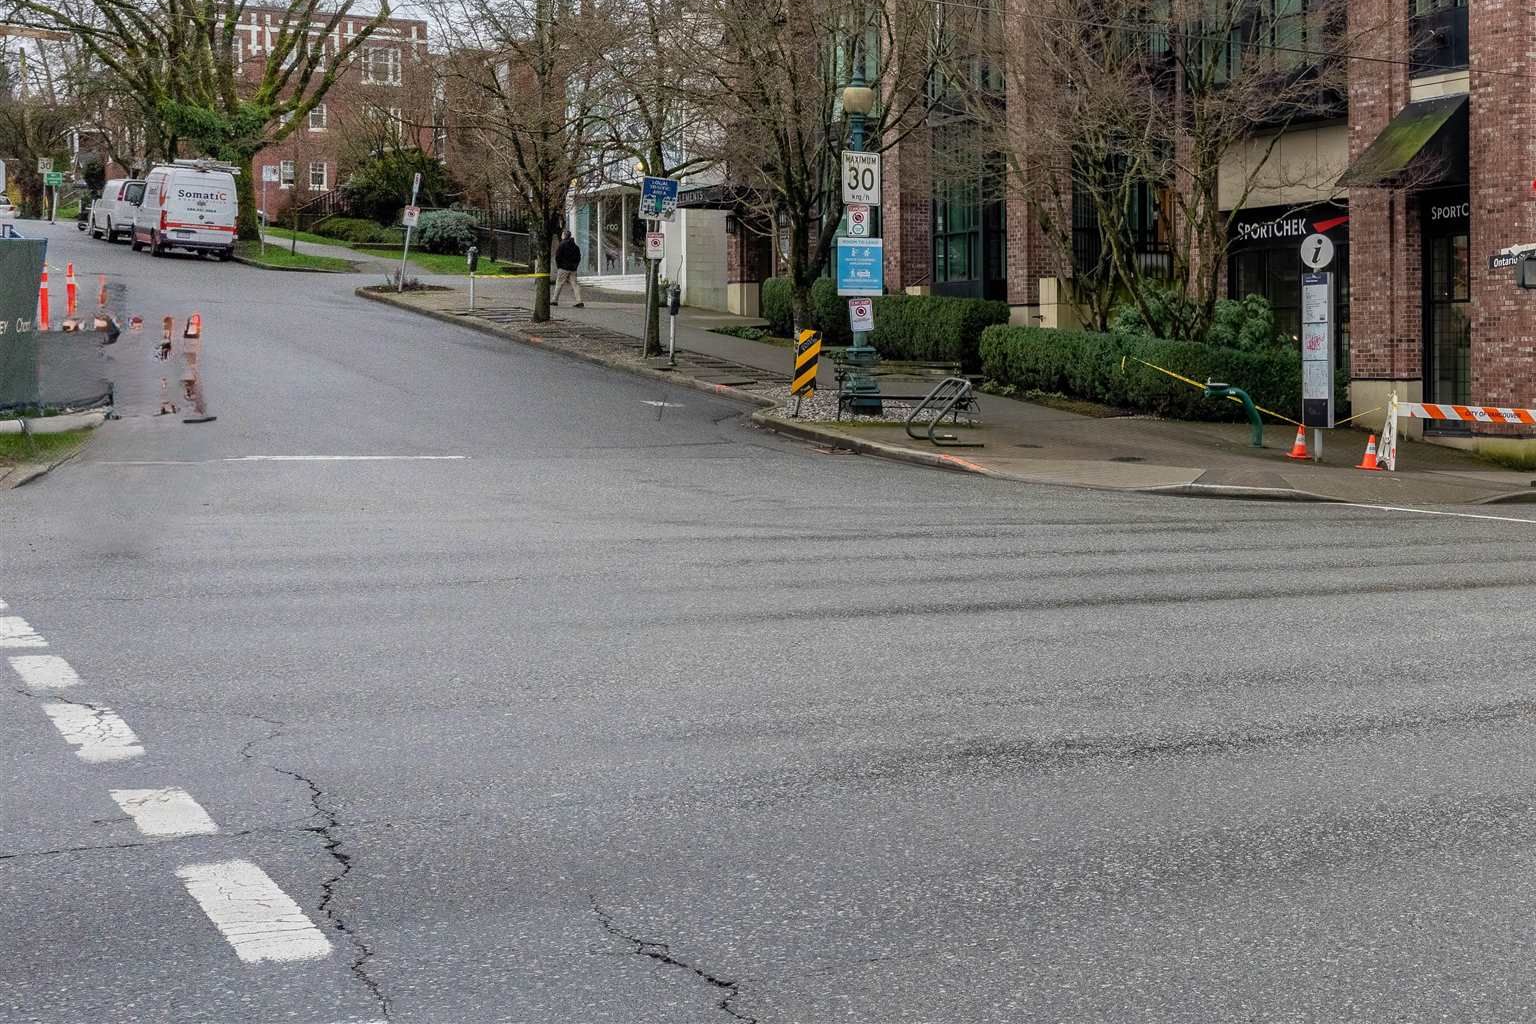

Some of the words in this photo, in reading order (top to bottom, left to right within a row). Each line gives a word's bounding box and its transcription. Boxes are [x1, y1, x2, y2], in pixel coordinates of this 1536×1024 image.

[845, 154, 877, 165] MAXIMUM
[847, 166, 875, 191] 30
[1237, 218, 1306, 240] SPORTCHEK
